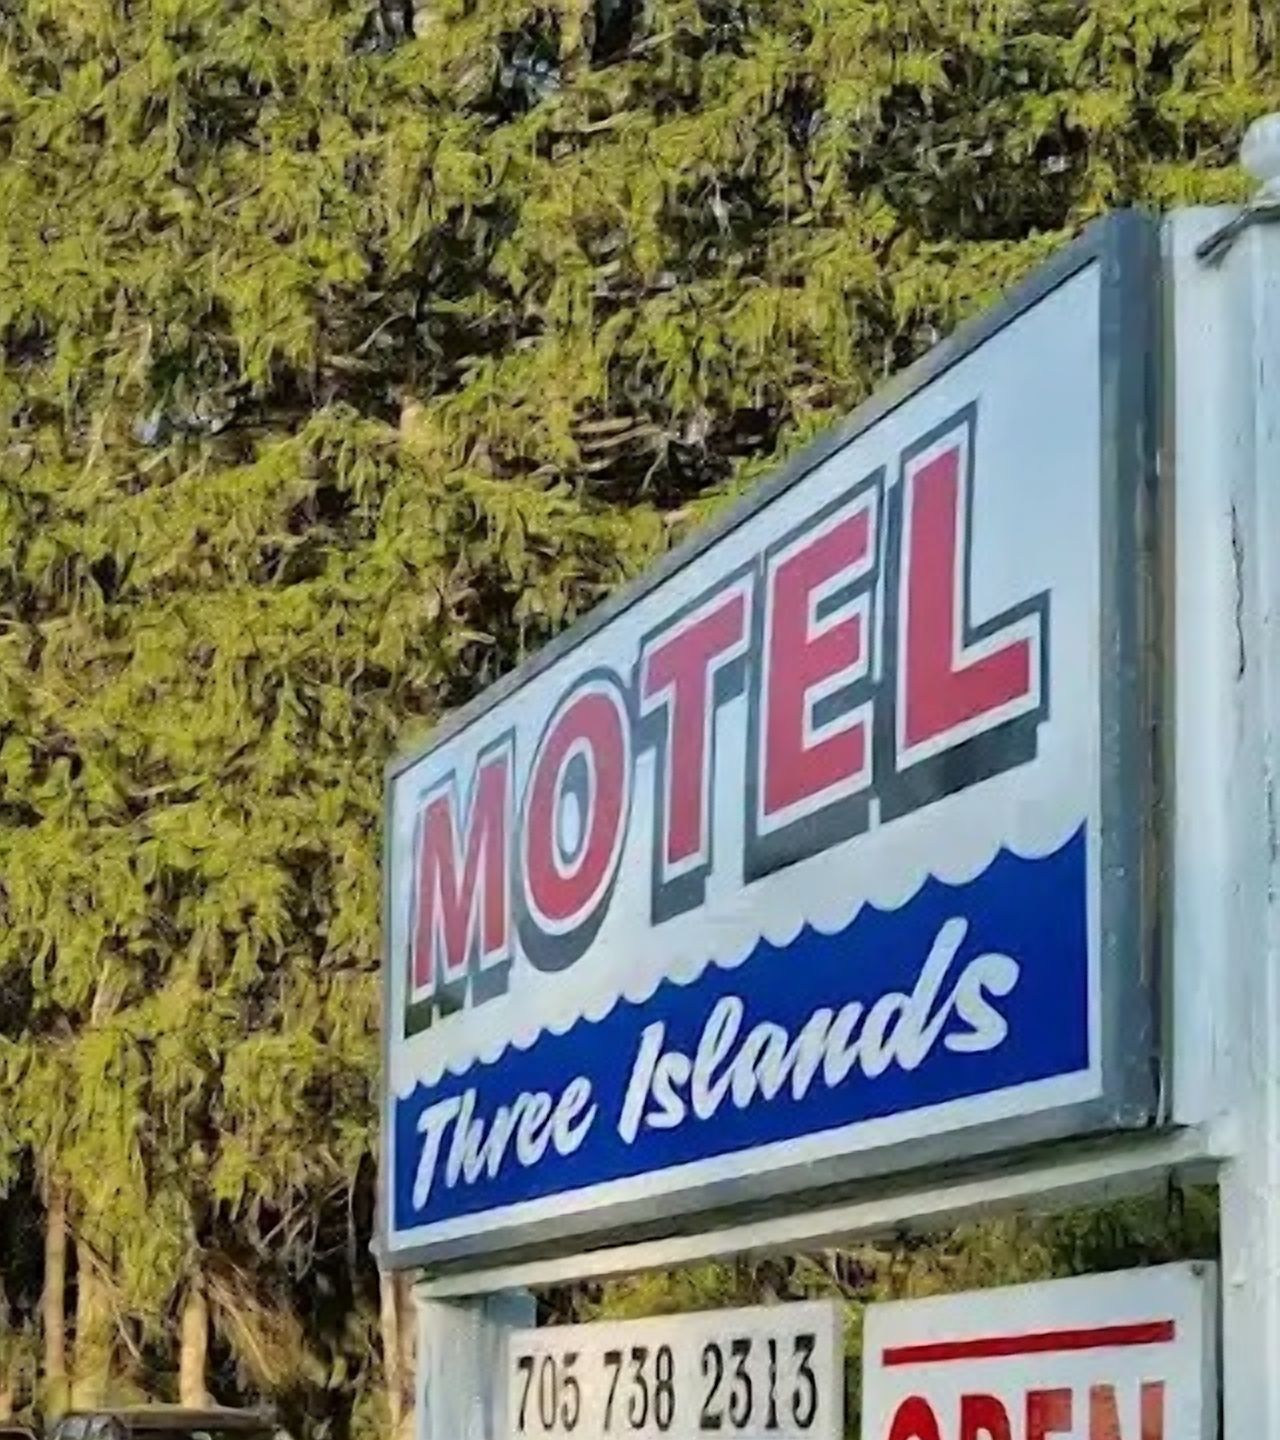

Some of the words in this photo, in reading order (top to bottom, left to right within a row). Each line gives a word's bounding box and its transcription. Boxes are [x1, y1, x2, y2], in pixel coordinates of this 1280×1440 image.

[406, 405, 1048, 1030] MOTEL
[413, 1075, 597, 1208] Three
[617, 916, 1020, 1142] Islands
[517, 1349, 582, 1433] 705
[603, 1343, 675, 1432] 738
[699, 1332, 819, 1431] 2313
